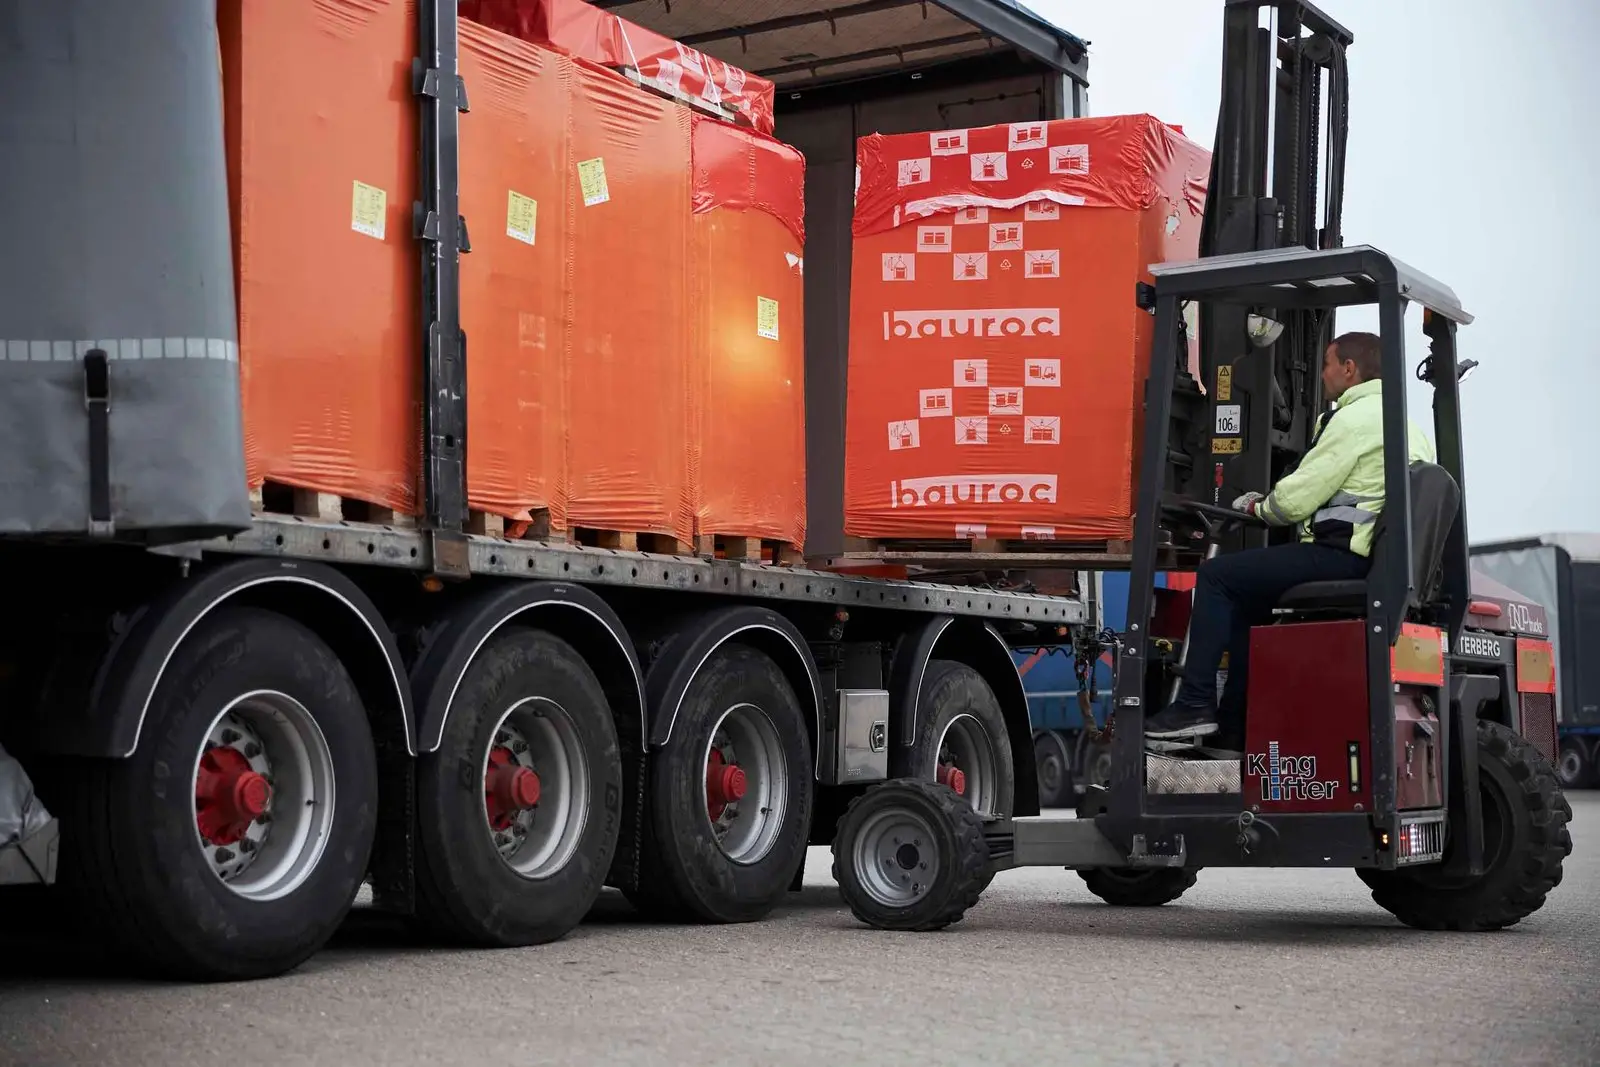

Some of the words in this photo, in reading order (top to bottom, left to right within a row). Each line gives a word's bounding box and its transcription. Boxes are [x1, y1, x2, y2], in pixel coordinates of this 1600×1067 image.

[884, 308, 1060, 340] bauroc
[1218, 417, 1233, 432] 106
[891, 474, 1058, 508] bauroc
[1529, 617, 1543, 633] trucks
[1247, 741, 1316, 779] King
[1260, 776, 1339, 801] lifter
